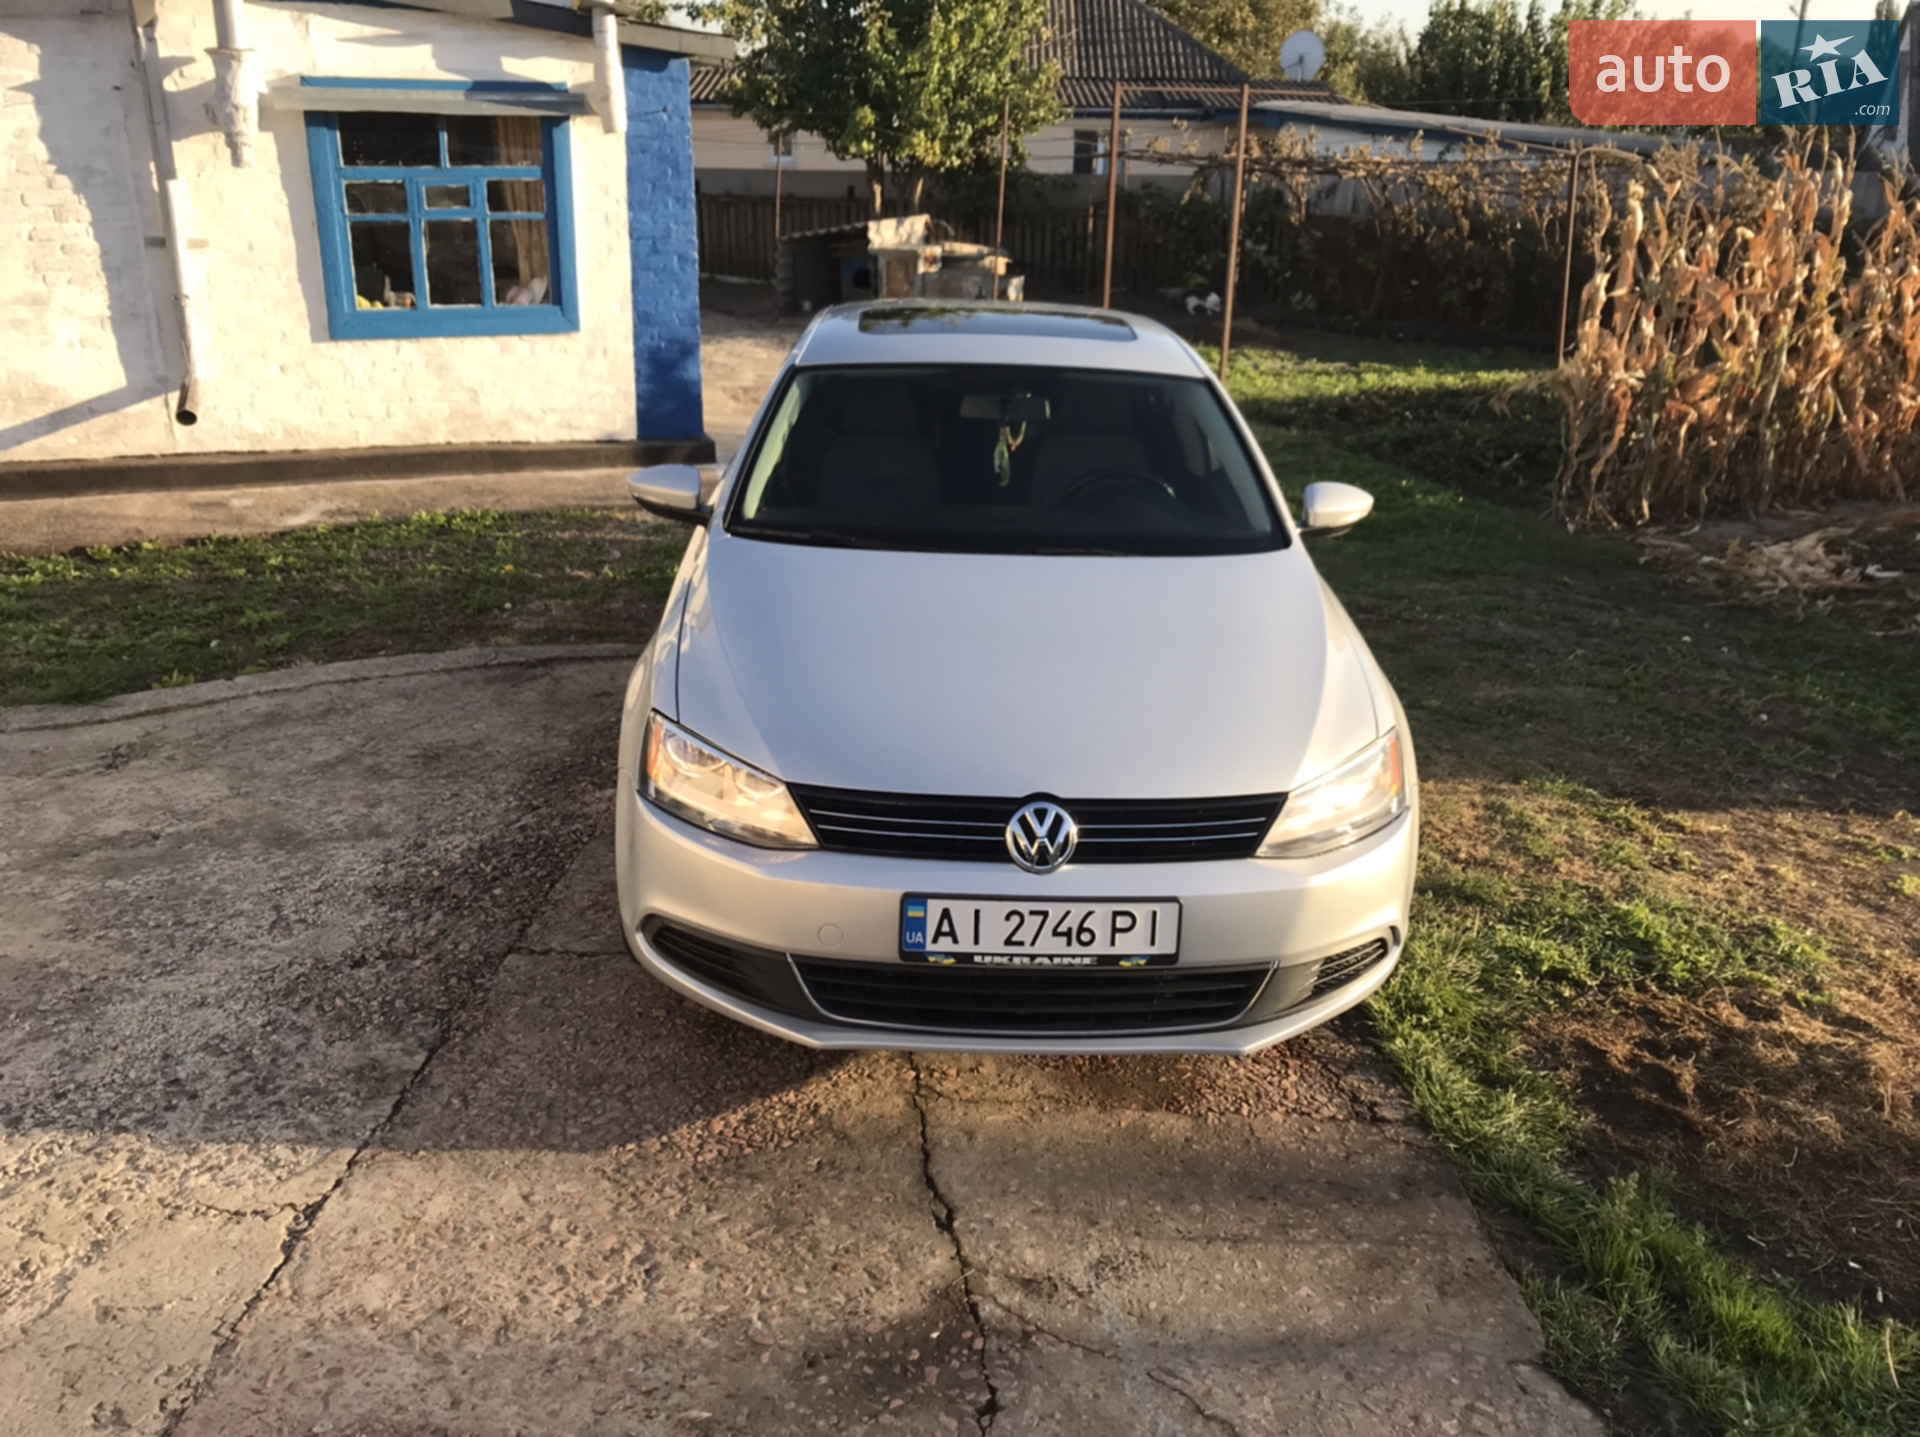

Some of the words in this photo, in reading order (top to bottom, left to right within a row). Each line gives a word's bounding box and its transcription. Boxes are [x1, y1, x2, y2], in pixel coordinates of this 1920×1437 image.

[931, 907, 981, 946] AI
[1003, 909, 1097, 948] 2746
[1110, 909, 1159, 948] PI
[906, 931, 924, 944] UA
[973, 954, 1098, 966] UKRAINE
